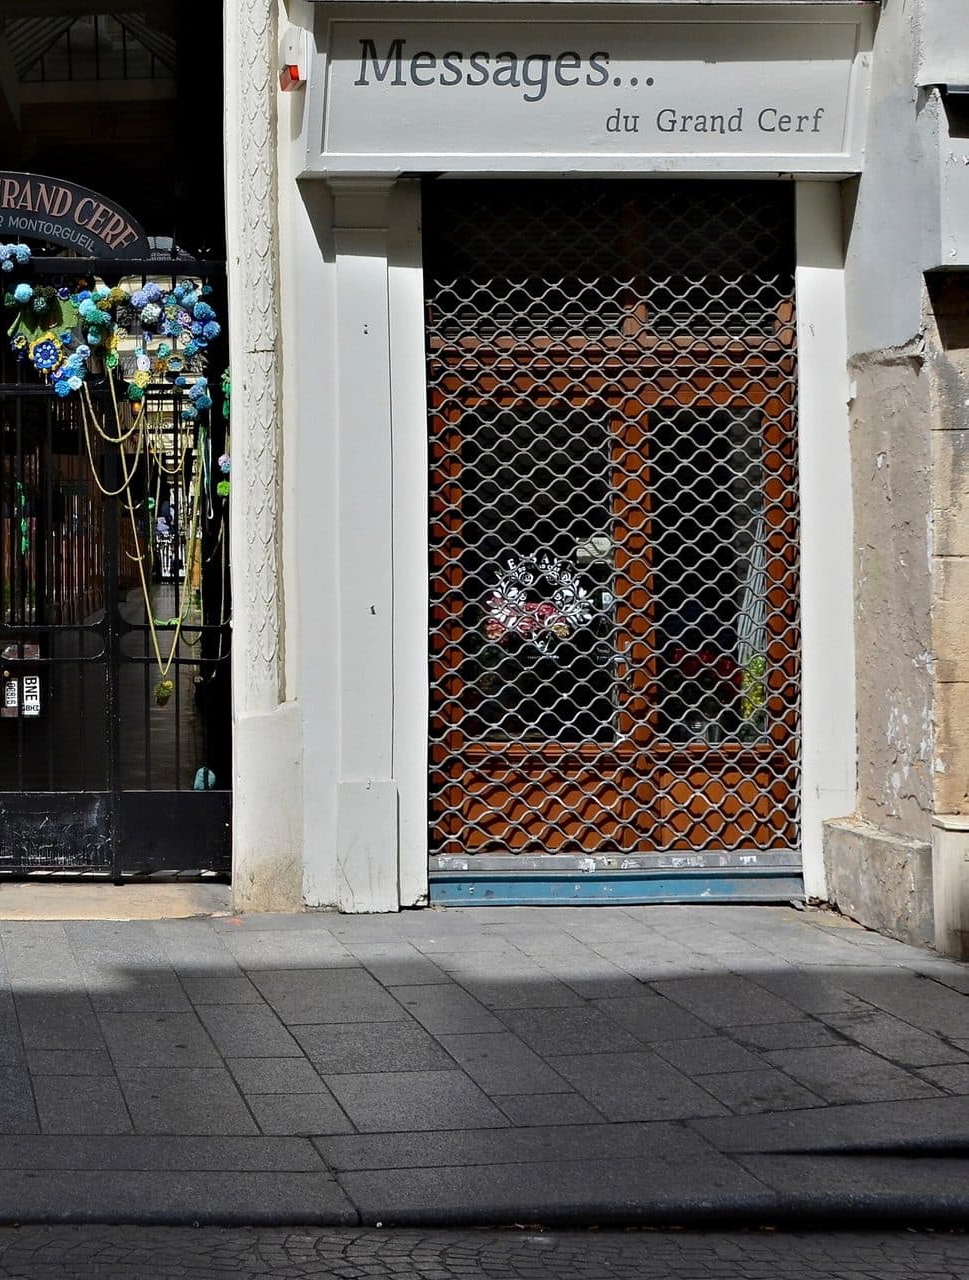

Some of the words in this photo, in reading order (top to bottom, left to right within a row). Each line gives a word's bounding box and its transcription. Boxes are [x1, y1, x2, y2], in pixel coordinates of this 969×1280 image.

[354, 38, 655, 102] Messages...
[605, 107, 639, 134] du
[656, 107, 743, 134] Grand
[758, 107, 826, 133] Cerf
[8, 216, 96, 253] MONTORGUEIL
[73, 197, 139, 251] CERF
